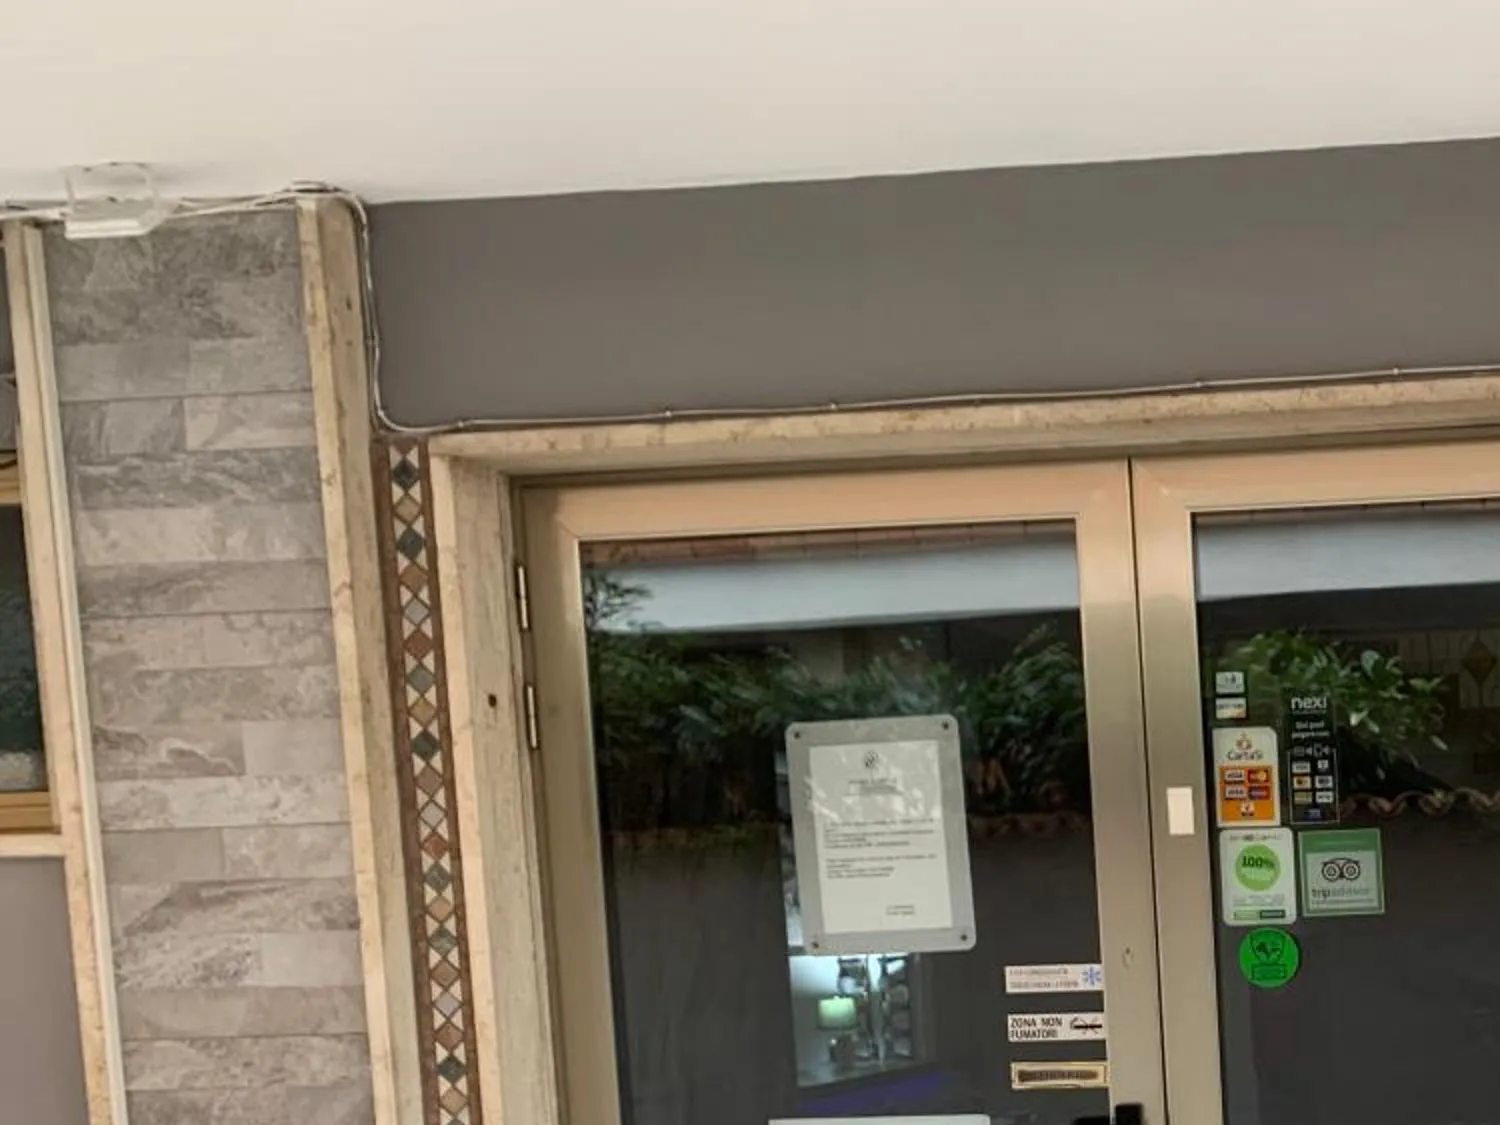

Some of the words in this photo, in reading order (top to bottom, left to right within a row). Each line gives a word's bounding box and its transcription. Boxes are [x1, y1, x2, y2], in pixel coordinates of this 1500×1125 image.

[1291, 694, 1328, 710] nexi
[1240, 855, 1276, 870] 100%
[1010, 1017, 1037, 1028] ZONA
[1040, 1016, 1063, 1027] NON
